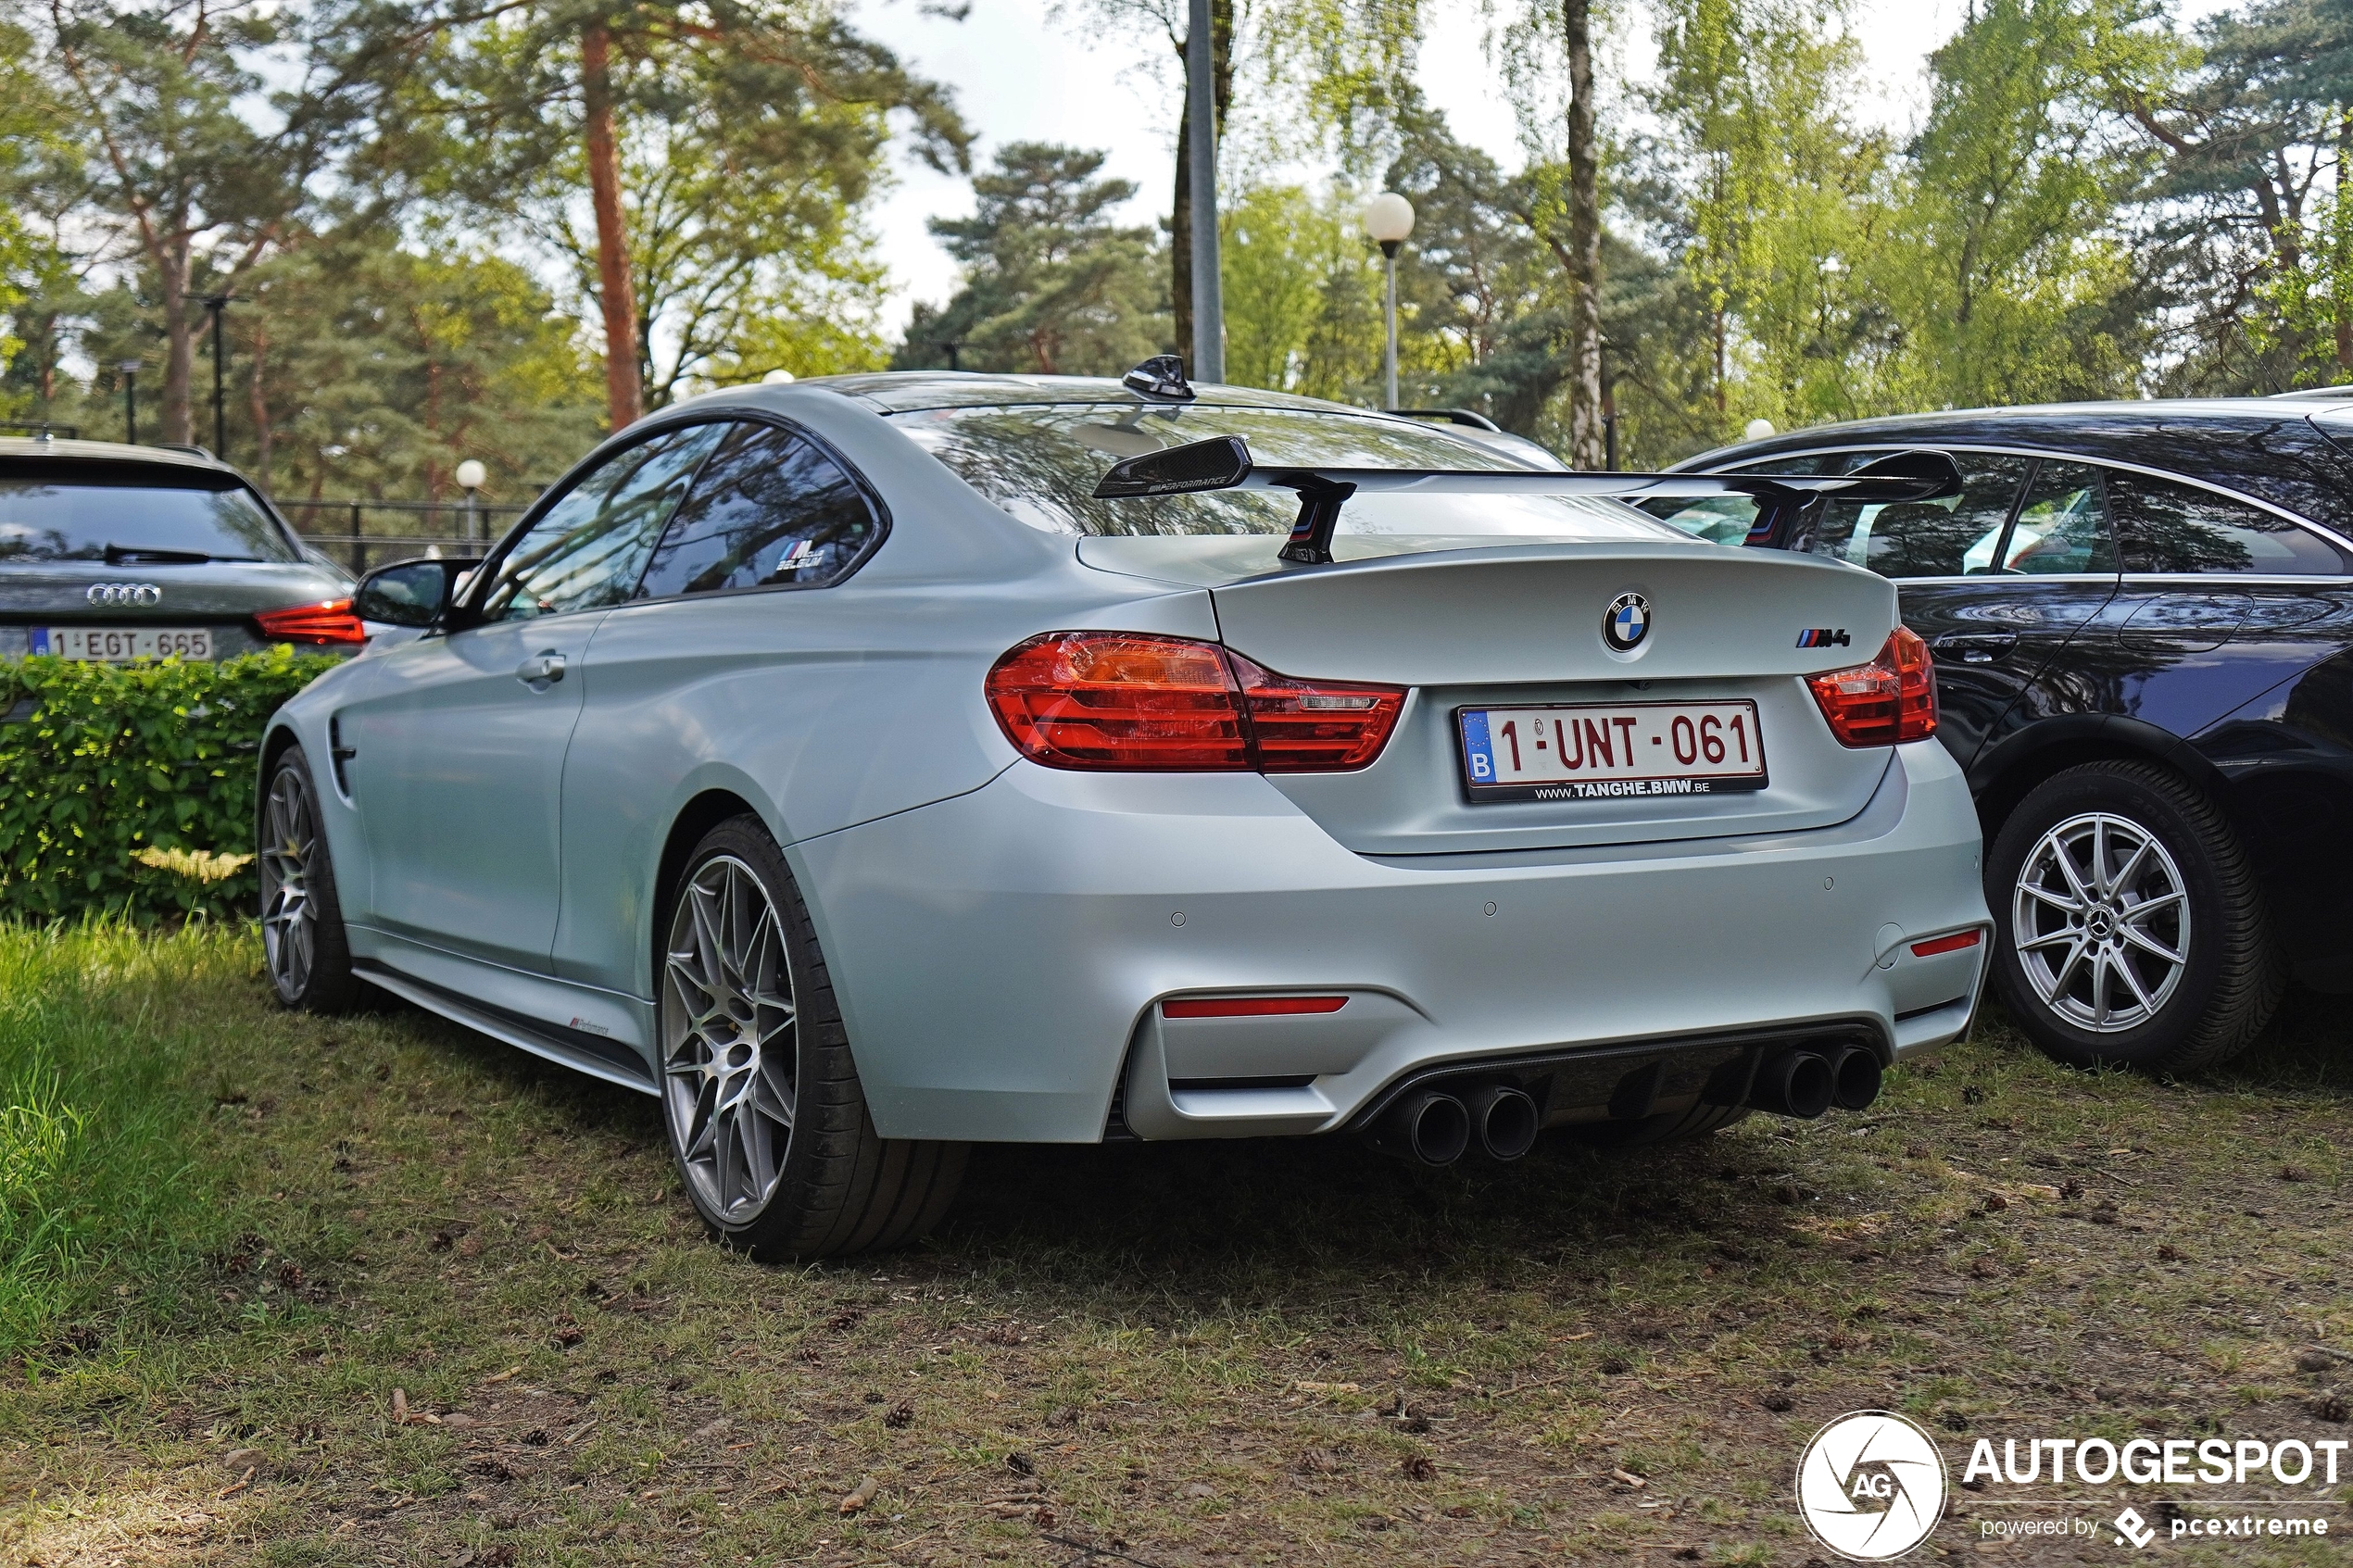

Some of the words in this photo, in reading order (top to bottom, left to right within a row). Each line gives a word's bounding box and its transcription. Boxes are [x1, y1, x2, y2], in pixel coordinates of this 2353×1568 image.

[1161, 476, 1227, 491] PERFORMANCE
[776, 556, 823, 571] BELGIUM
[1611, 595, 1650, 615] BMW
[1809, 629, 1851, 647] M4
[1472, 753, 1491, 778] B
